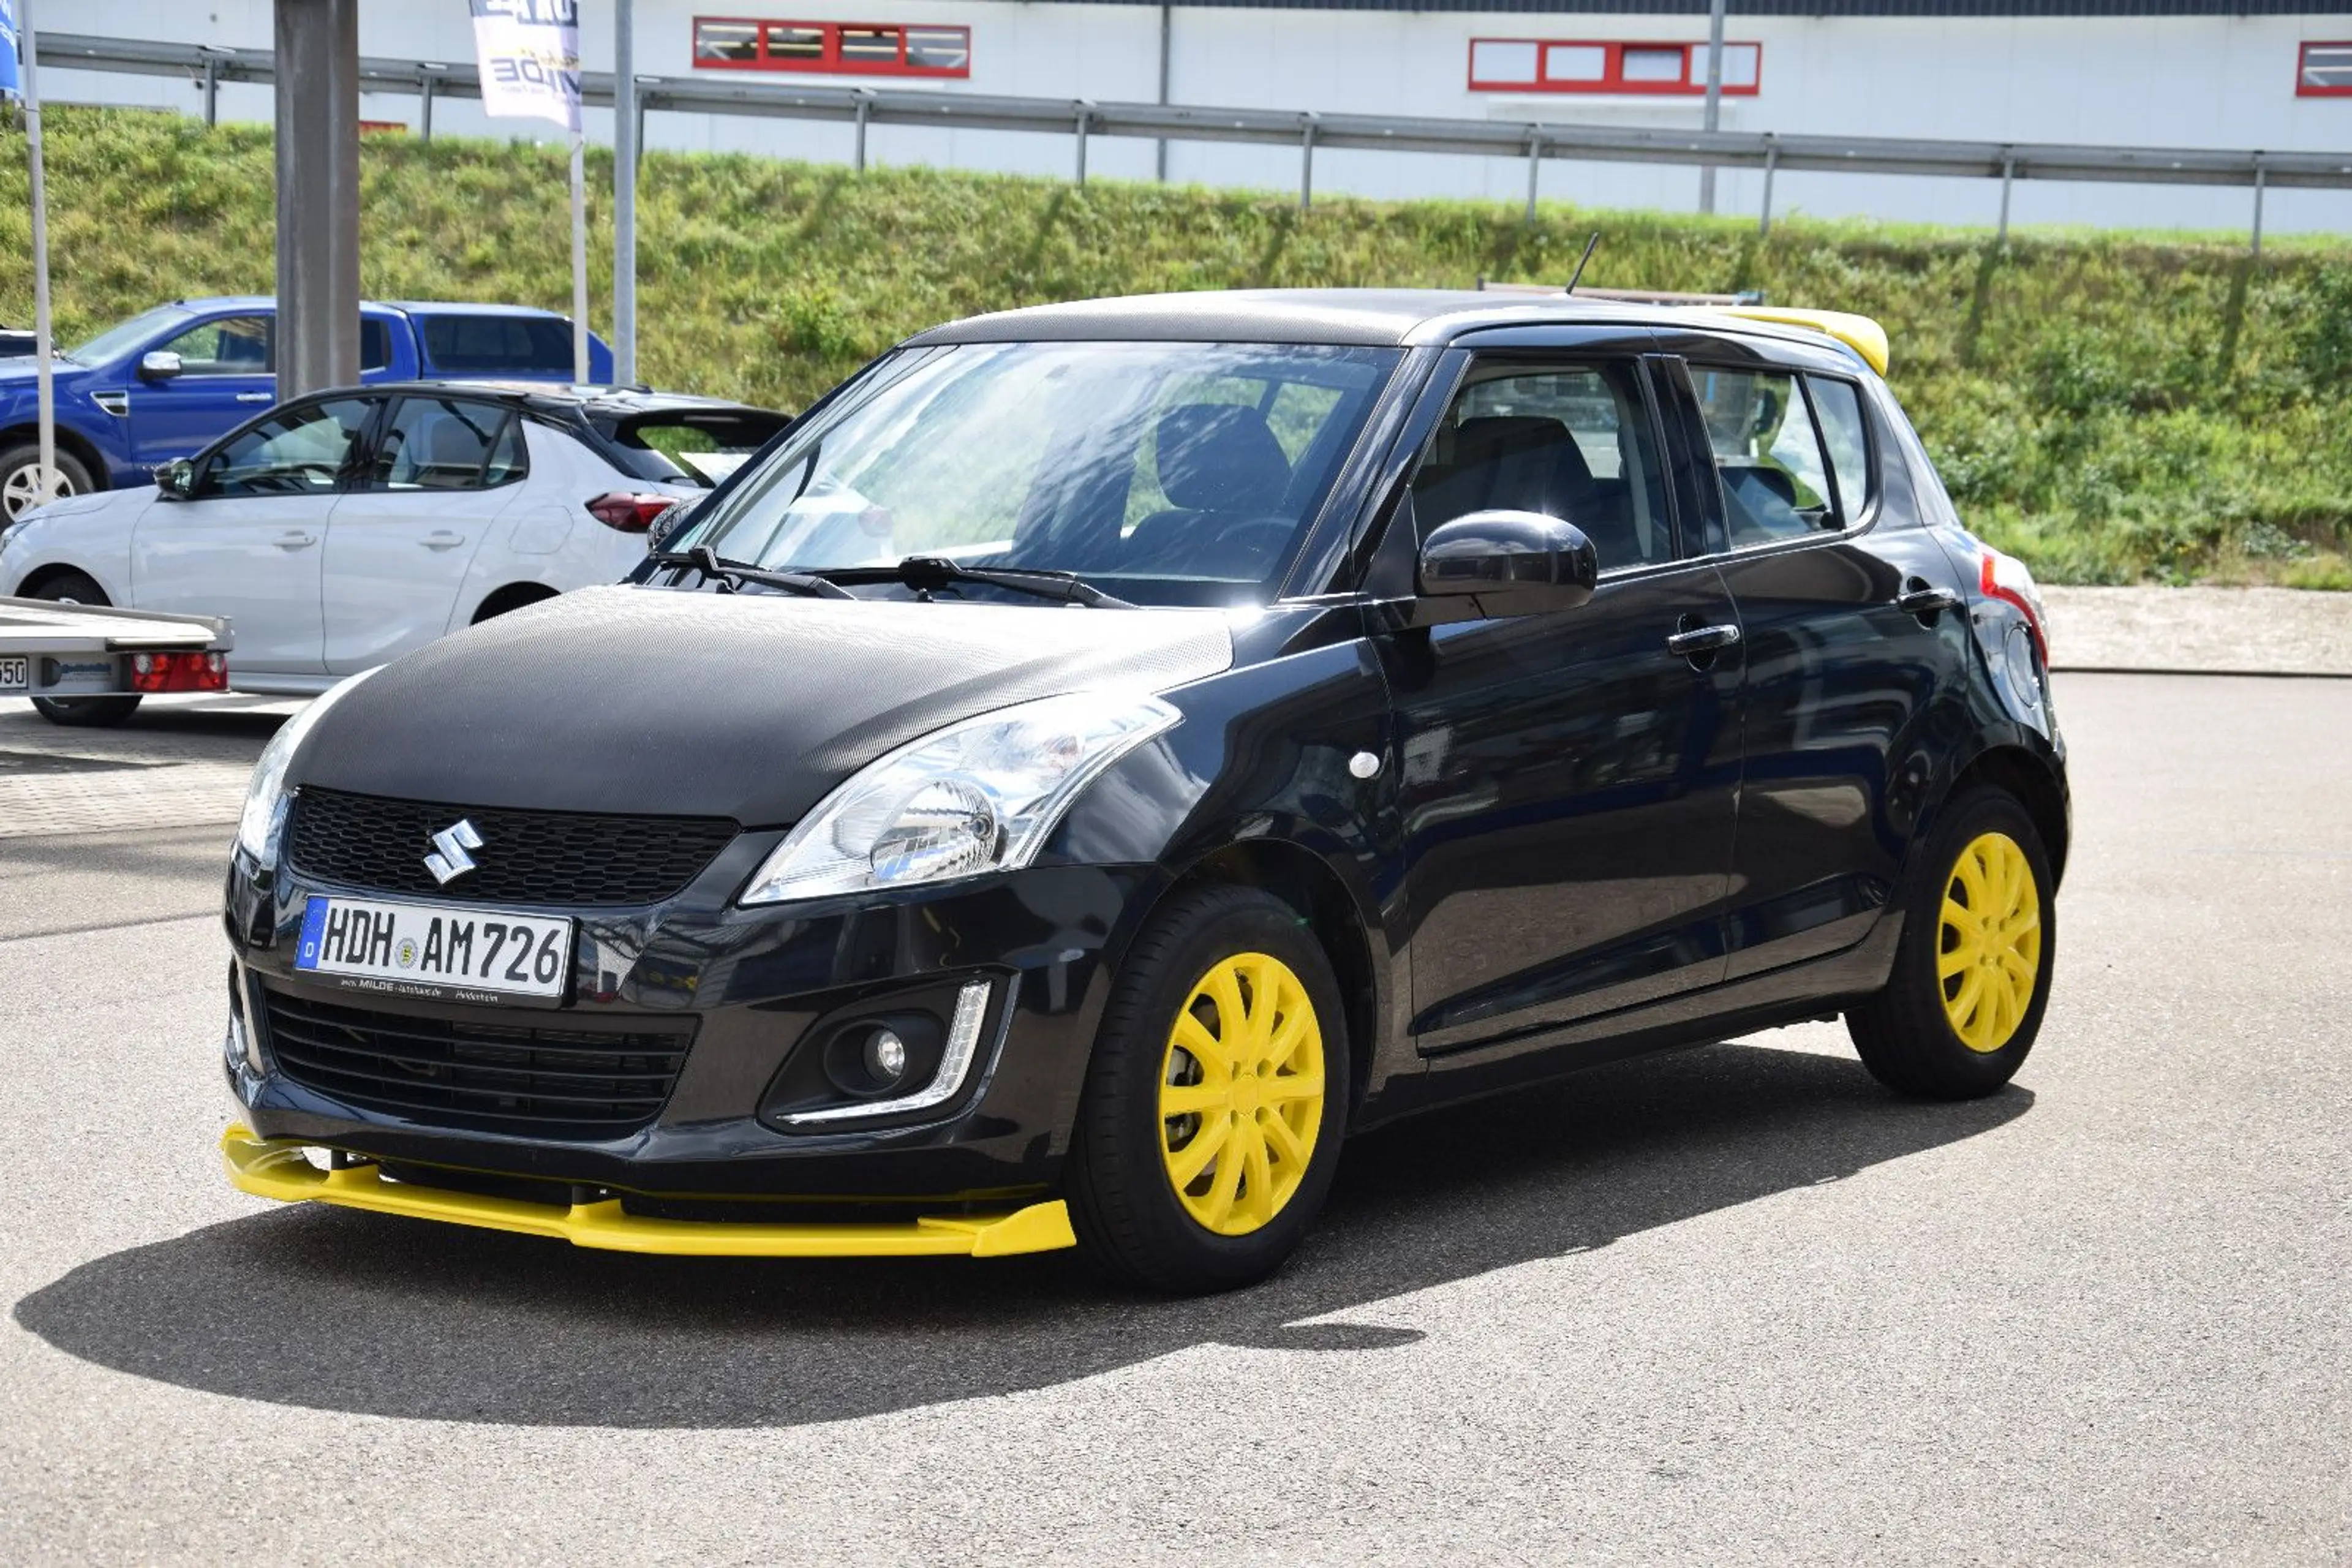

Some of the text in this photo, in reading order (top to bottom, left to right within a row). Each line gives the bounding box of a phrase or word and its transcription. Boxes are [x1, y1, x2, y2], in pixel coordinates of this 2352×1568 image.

[0, 661, 25, 684] 50
[304, 941, 315, 958] D
[322, 907, 560, 984] HDH AM 726
